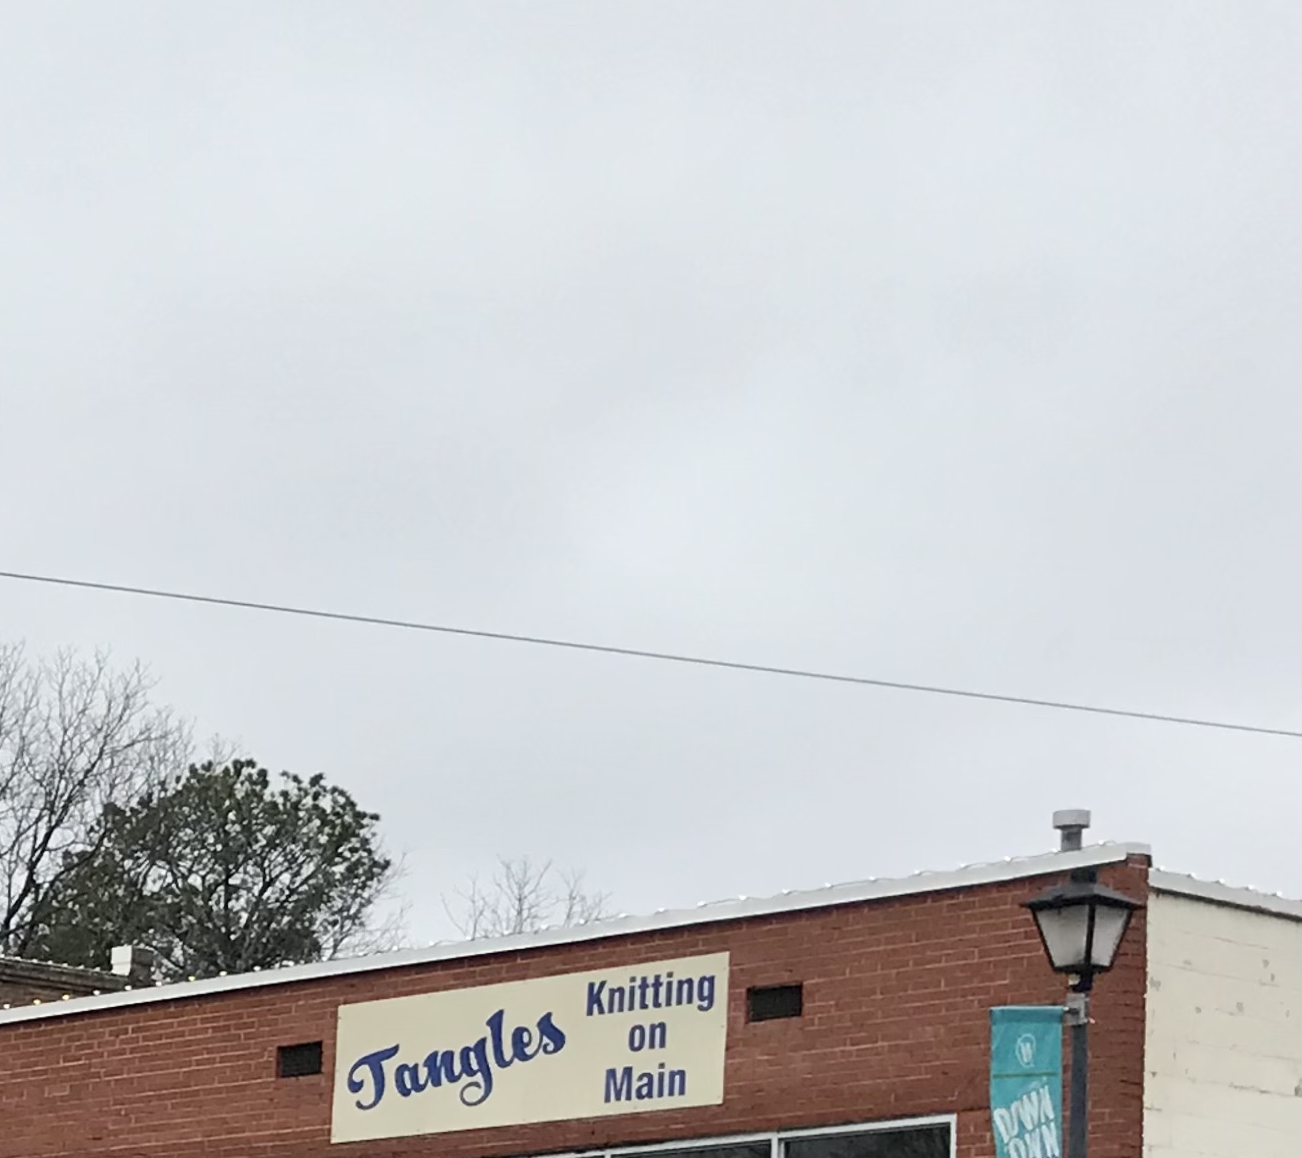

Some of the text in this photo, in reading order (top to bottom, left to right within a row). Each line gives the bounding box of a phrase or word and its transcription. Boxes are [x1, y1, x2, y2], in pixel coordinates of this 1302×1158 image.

[586, 971, 716, 1017] Knitting
[628, 1021, 667, 1052] on
[347, 1009, 566, 1111] Tangles
[603, 1062, 687, 1104] Main
